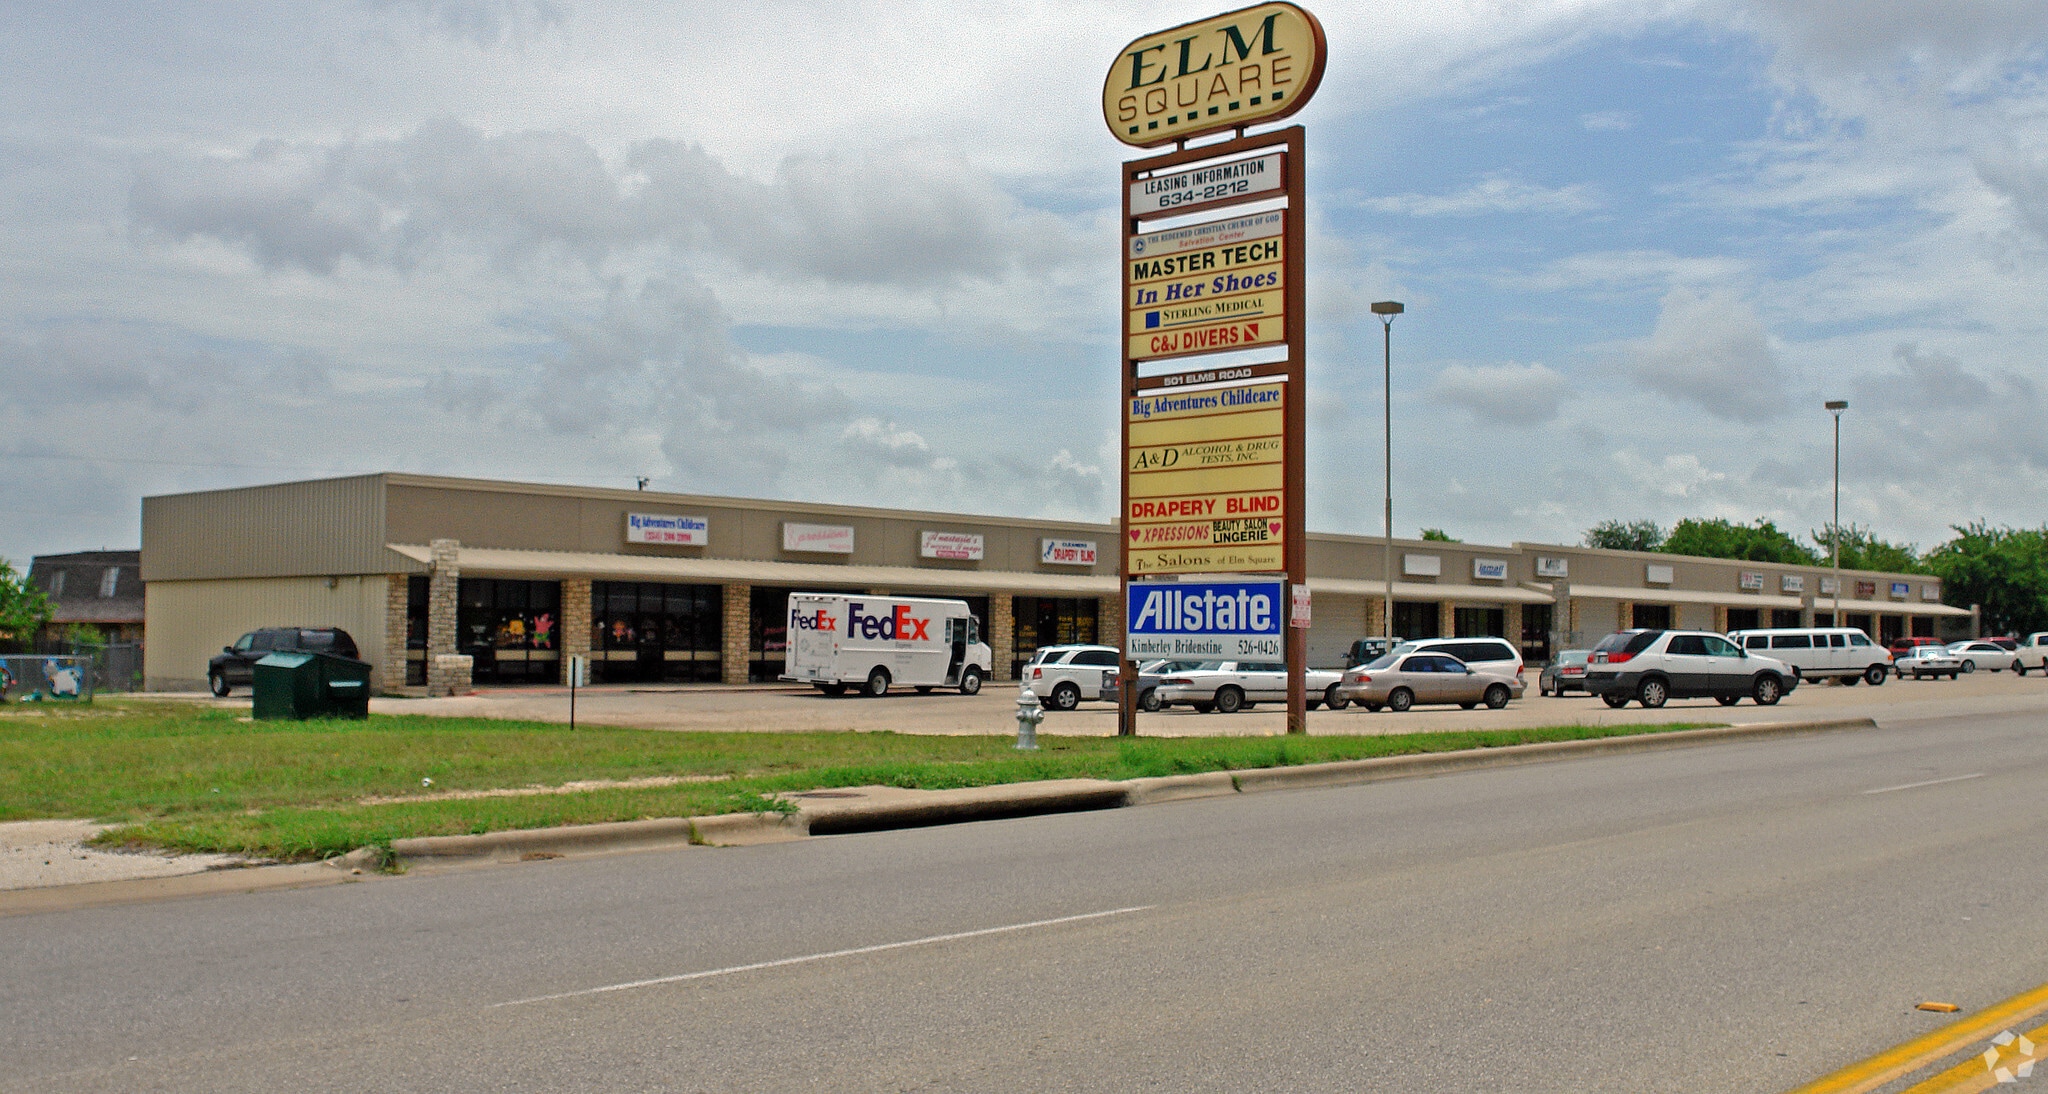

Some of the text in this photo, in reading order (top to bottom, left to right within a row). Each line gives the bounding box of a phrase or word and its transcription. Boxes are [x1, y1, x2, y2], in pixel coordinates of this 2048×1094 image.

[1124, 12, 1283, 92] ELM
[1118, 55, 1292, 122] SQUARE
[1145, 159, 1265, 195] LEASING INFORMATION
[1159, 179, 1249, 207] 634-2212
[1148, 214, 1280, 244] THE REDEEMED CHRISTIAN CHURCH OF GOD
[1178, 231, 1245, 249] Salvation Center
[1134, 241, 1278, 281] MASTER TECH
[1135, 271, 1278, 306] In Her Shoes
[1150, 326, 1239, 354] C&J DIVERS
[1163, 368, 1252, 387] 501 ELMS ROAD
[1132, 388, 1280, 418] Big Adventures Childcare
[1182, 444, 1232, 456] ALCOHOL
[1235, 443, 1244, 452] &
[1247, 440, 1280, 450] DRUG
[1201, 452, 1259, 464] TESTS, INC.
[1131, 495, 1280, 518] DRAPERY BLIND
[1143, 525, 1210, 543] XPRESSIONS
[1213, 518, 1268, 532] BEAUTY SALON
[1213, 530, 1268, 543] LINGERIE
[1135, 554, 1276, 571] The Salons of Elm Square
[791, 608, 836, 631] FedEx
[848, 603, 930, 641] FedEx
[1134, 589, 1271, 631] Allstate
[1131, 639, 1279, 656] Kimberley Bridenstine 526-0426
